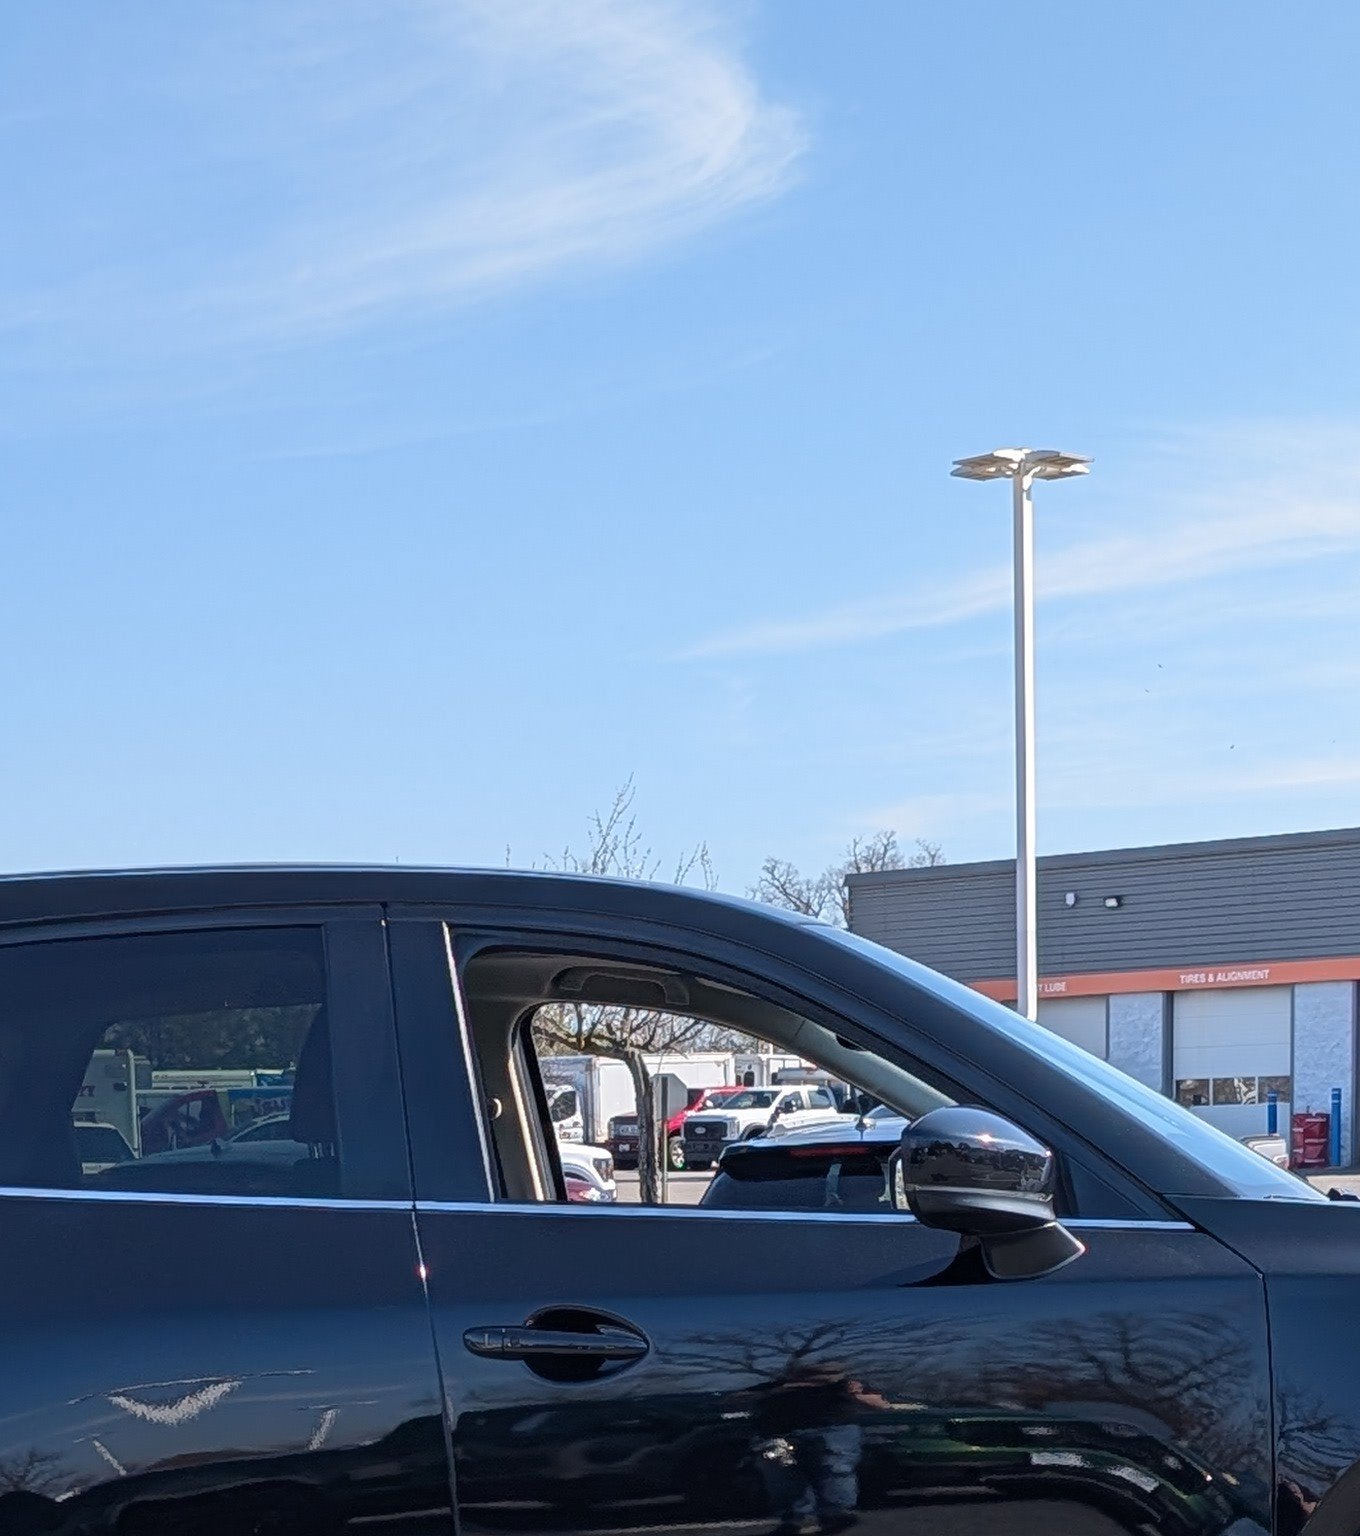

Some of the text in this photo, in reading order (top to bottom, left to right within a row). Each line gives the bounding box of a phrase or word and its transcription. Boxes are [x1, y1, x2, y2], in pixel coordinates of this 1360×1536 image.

[1179, 969, 1270, 984] TIRES & ALIGNMENT
